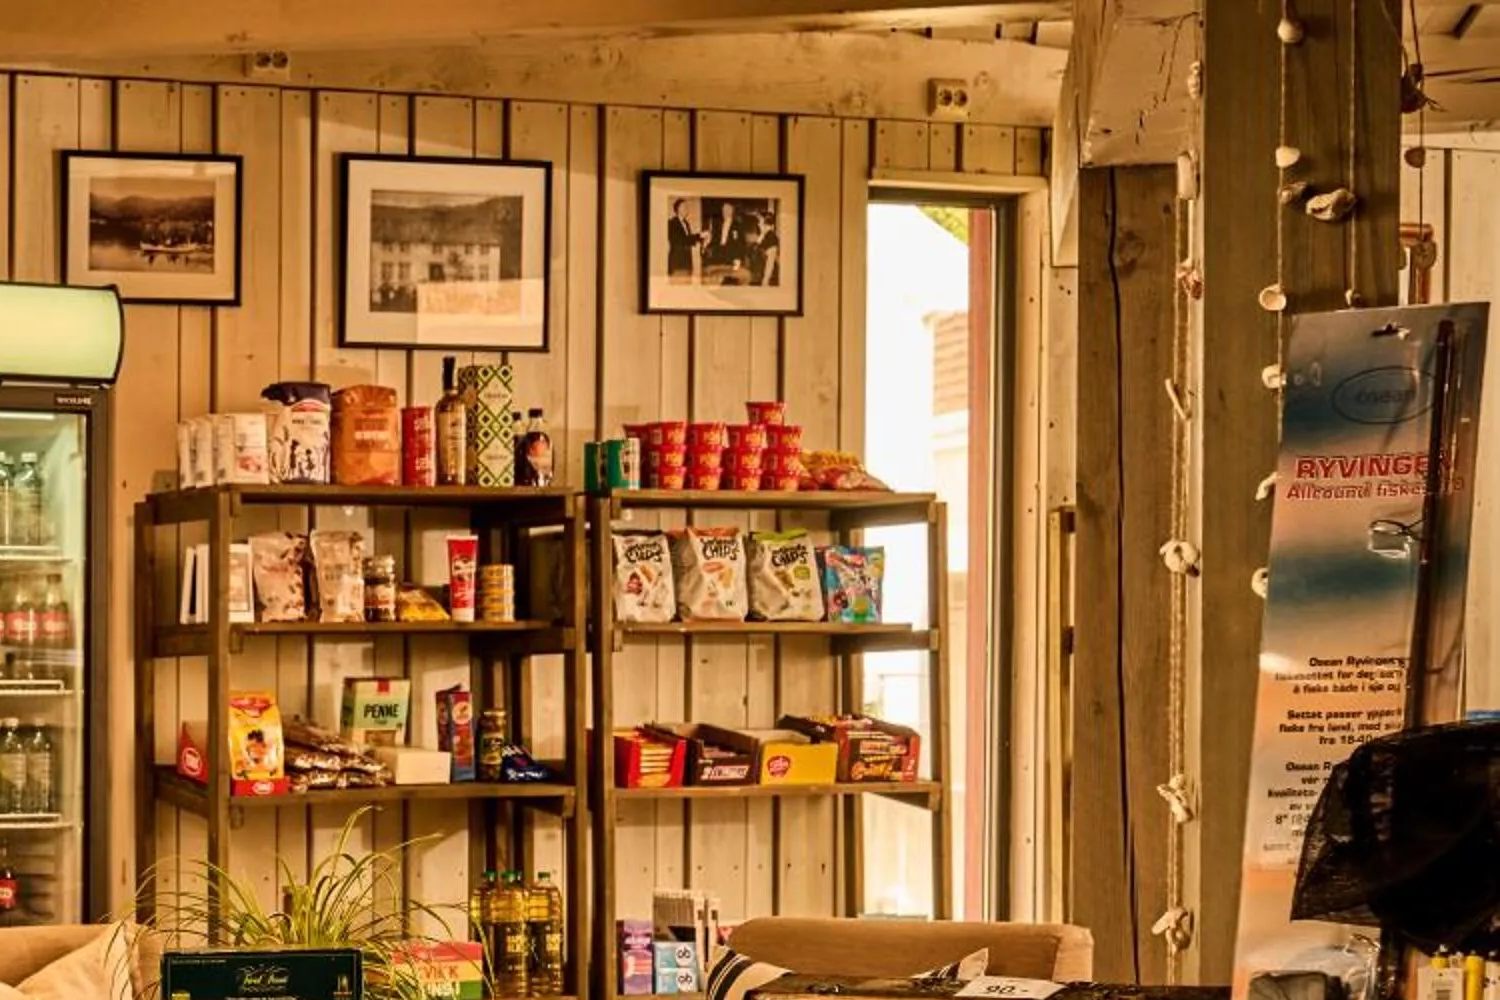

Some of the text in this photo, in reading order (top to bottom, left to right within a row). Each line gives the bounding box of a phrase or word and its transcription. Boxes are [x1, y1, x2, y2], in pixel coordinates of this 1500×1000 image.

[1309, 657, 1343, 667] Ocean
[363, 703, 399, 718] PENNE
[1287, 709, 1322, 720] Settet
[1326, 710, 1364, 721] passer
